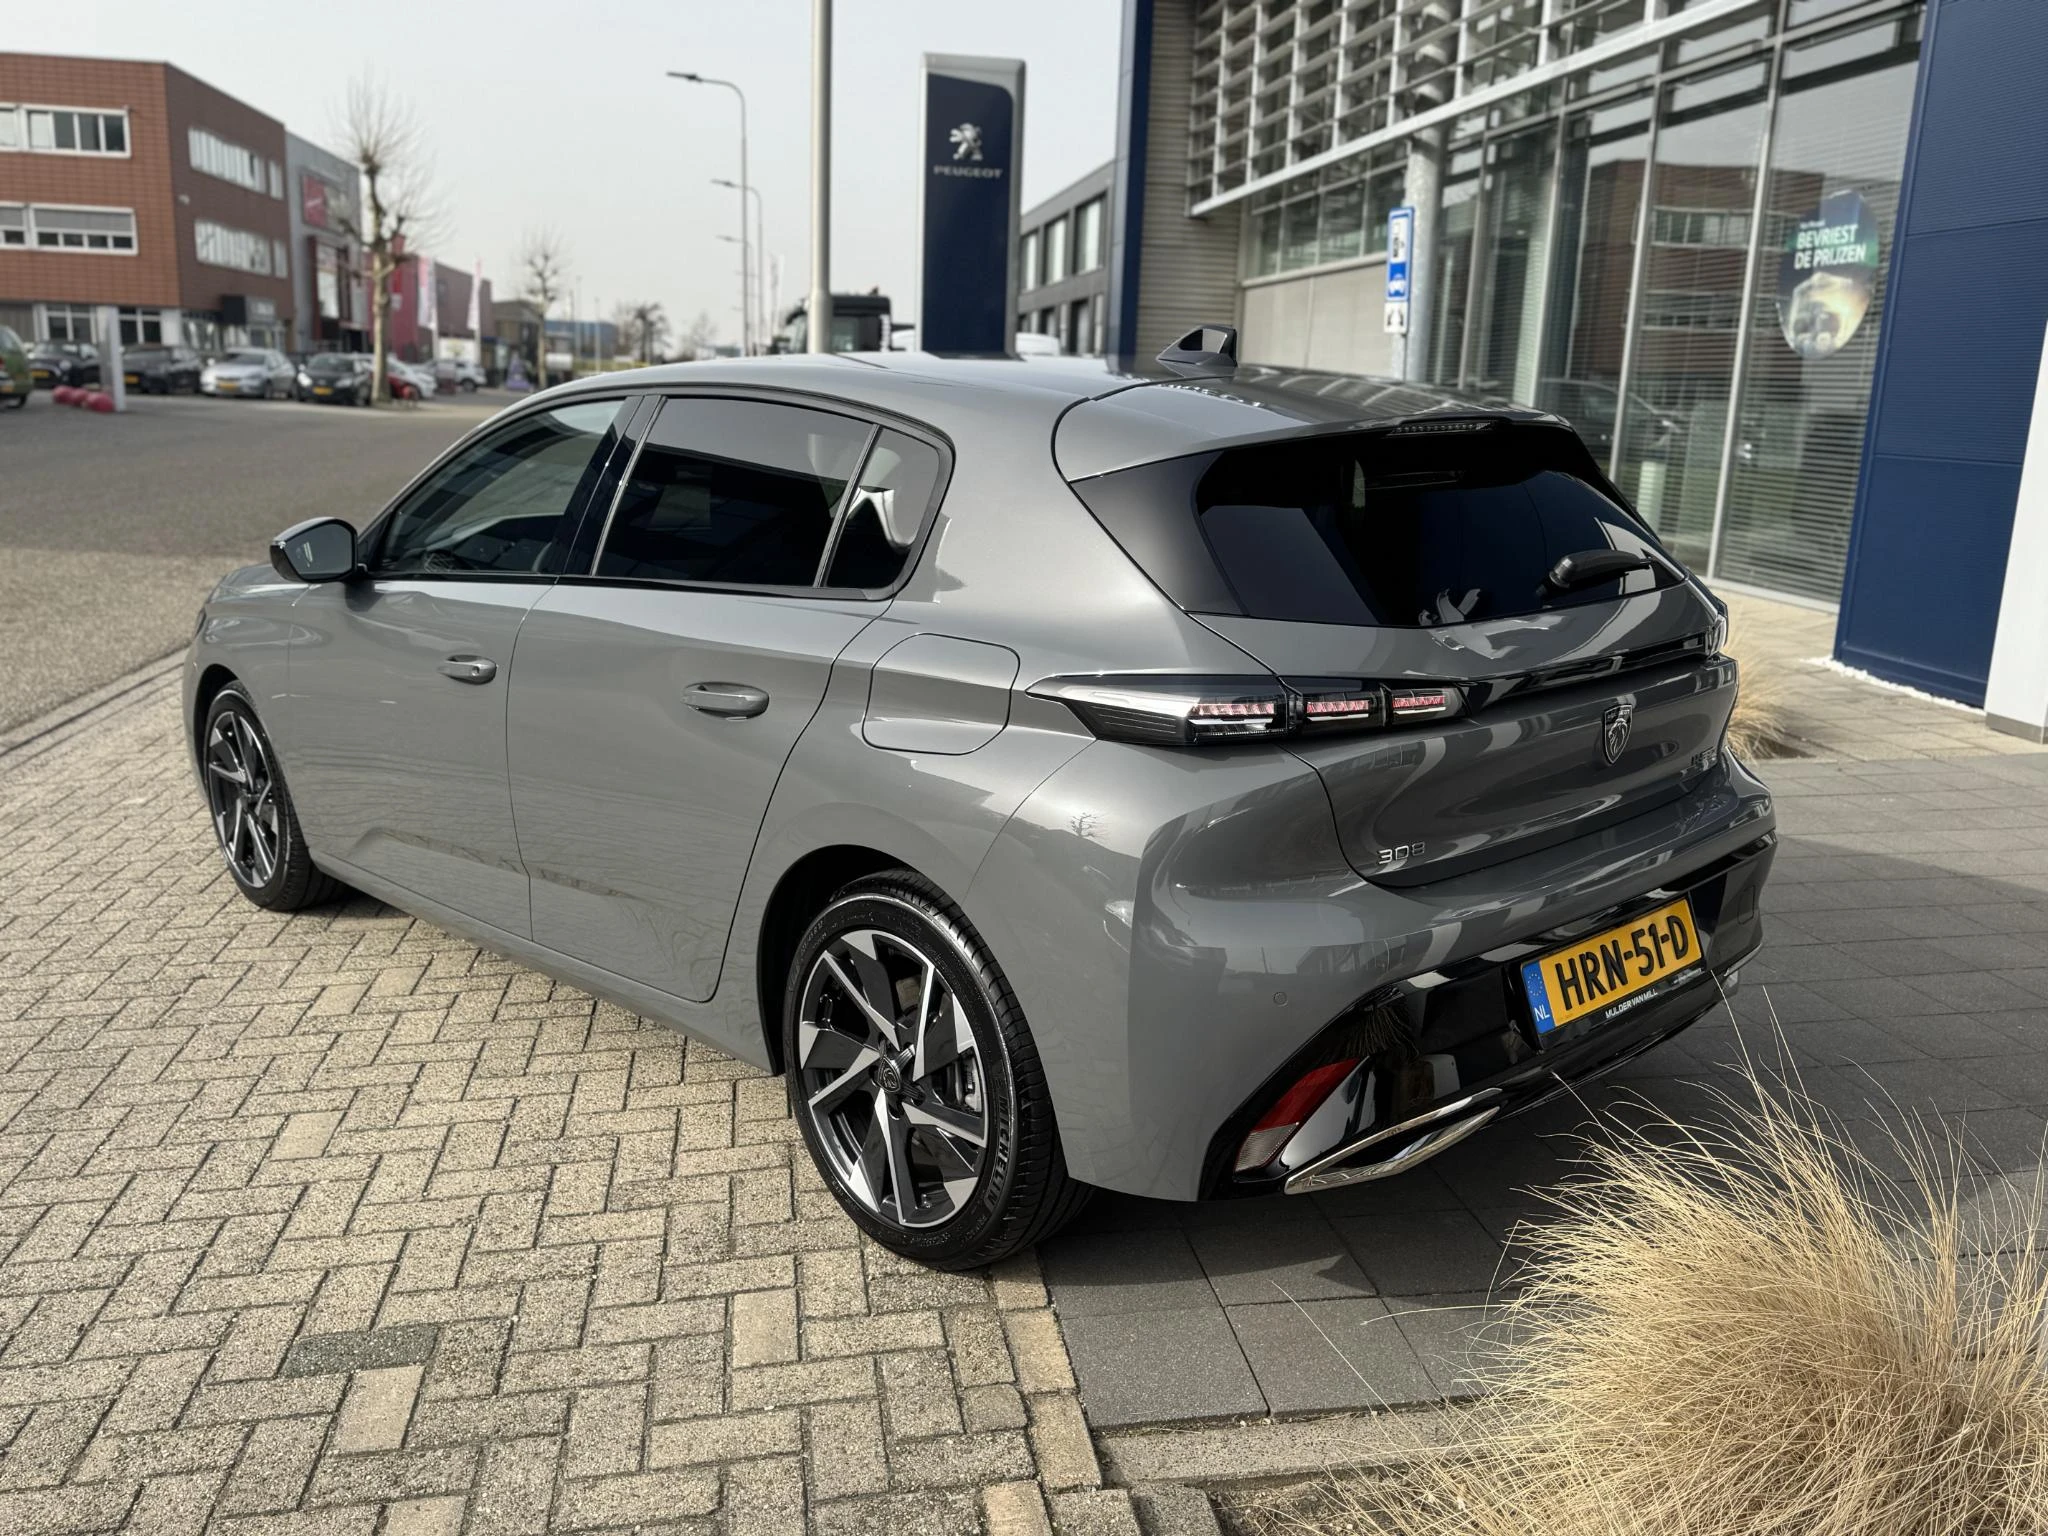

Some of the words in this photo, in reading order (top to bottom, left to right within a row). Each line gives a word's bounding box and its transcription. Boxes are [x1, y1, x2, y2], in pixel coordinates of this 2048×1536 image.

[933, 164, 1003, 178] PEUGEOT
[1796, 224, 1858, 249] BEVRIEST
[1794, 250, 1812, 270] DE
[1813, 243, 1866, 268] PRIJZEN
[1379, 841, 1425, 864] 308
[1555, 915, 1689, 1011] HRN-51-D
[1534, 1005, 1550, 1022] NL
[1605, 1001, 1632, 1018] MULDER
[986, 1095, 1010, 1208] MICHELIN
